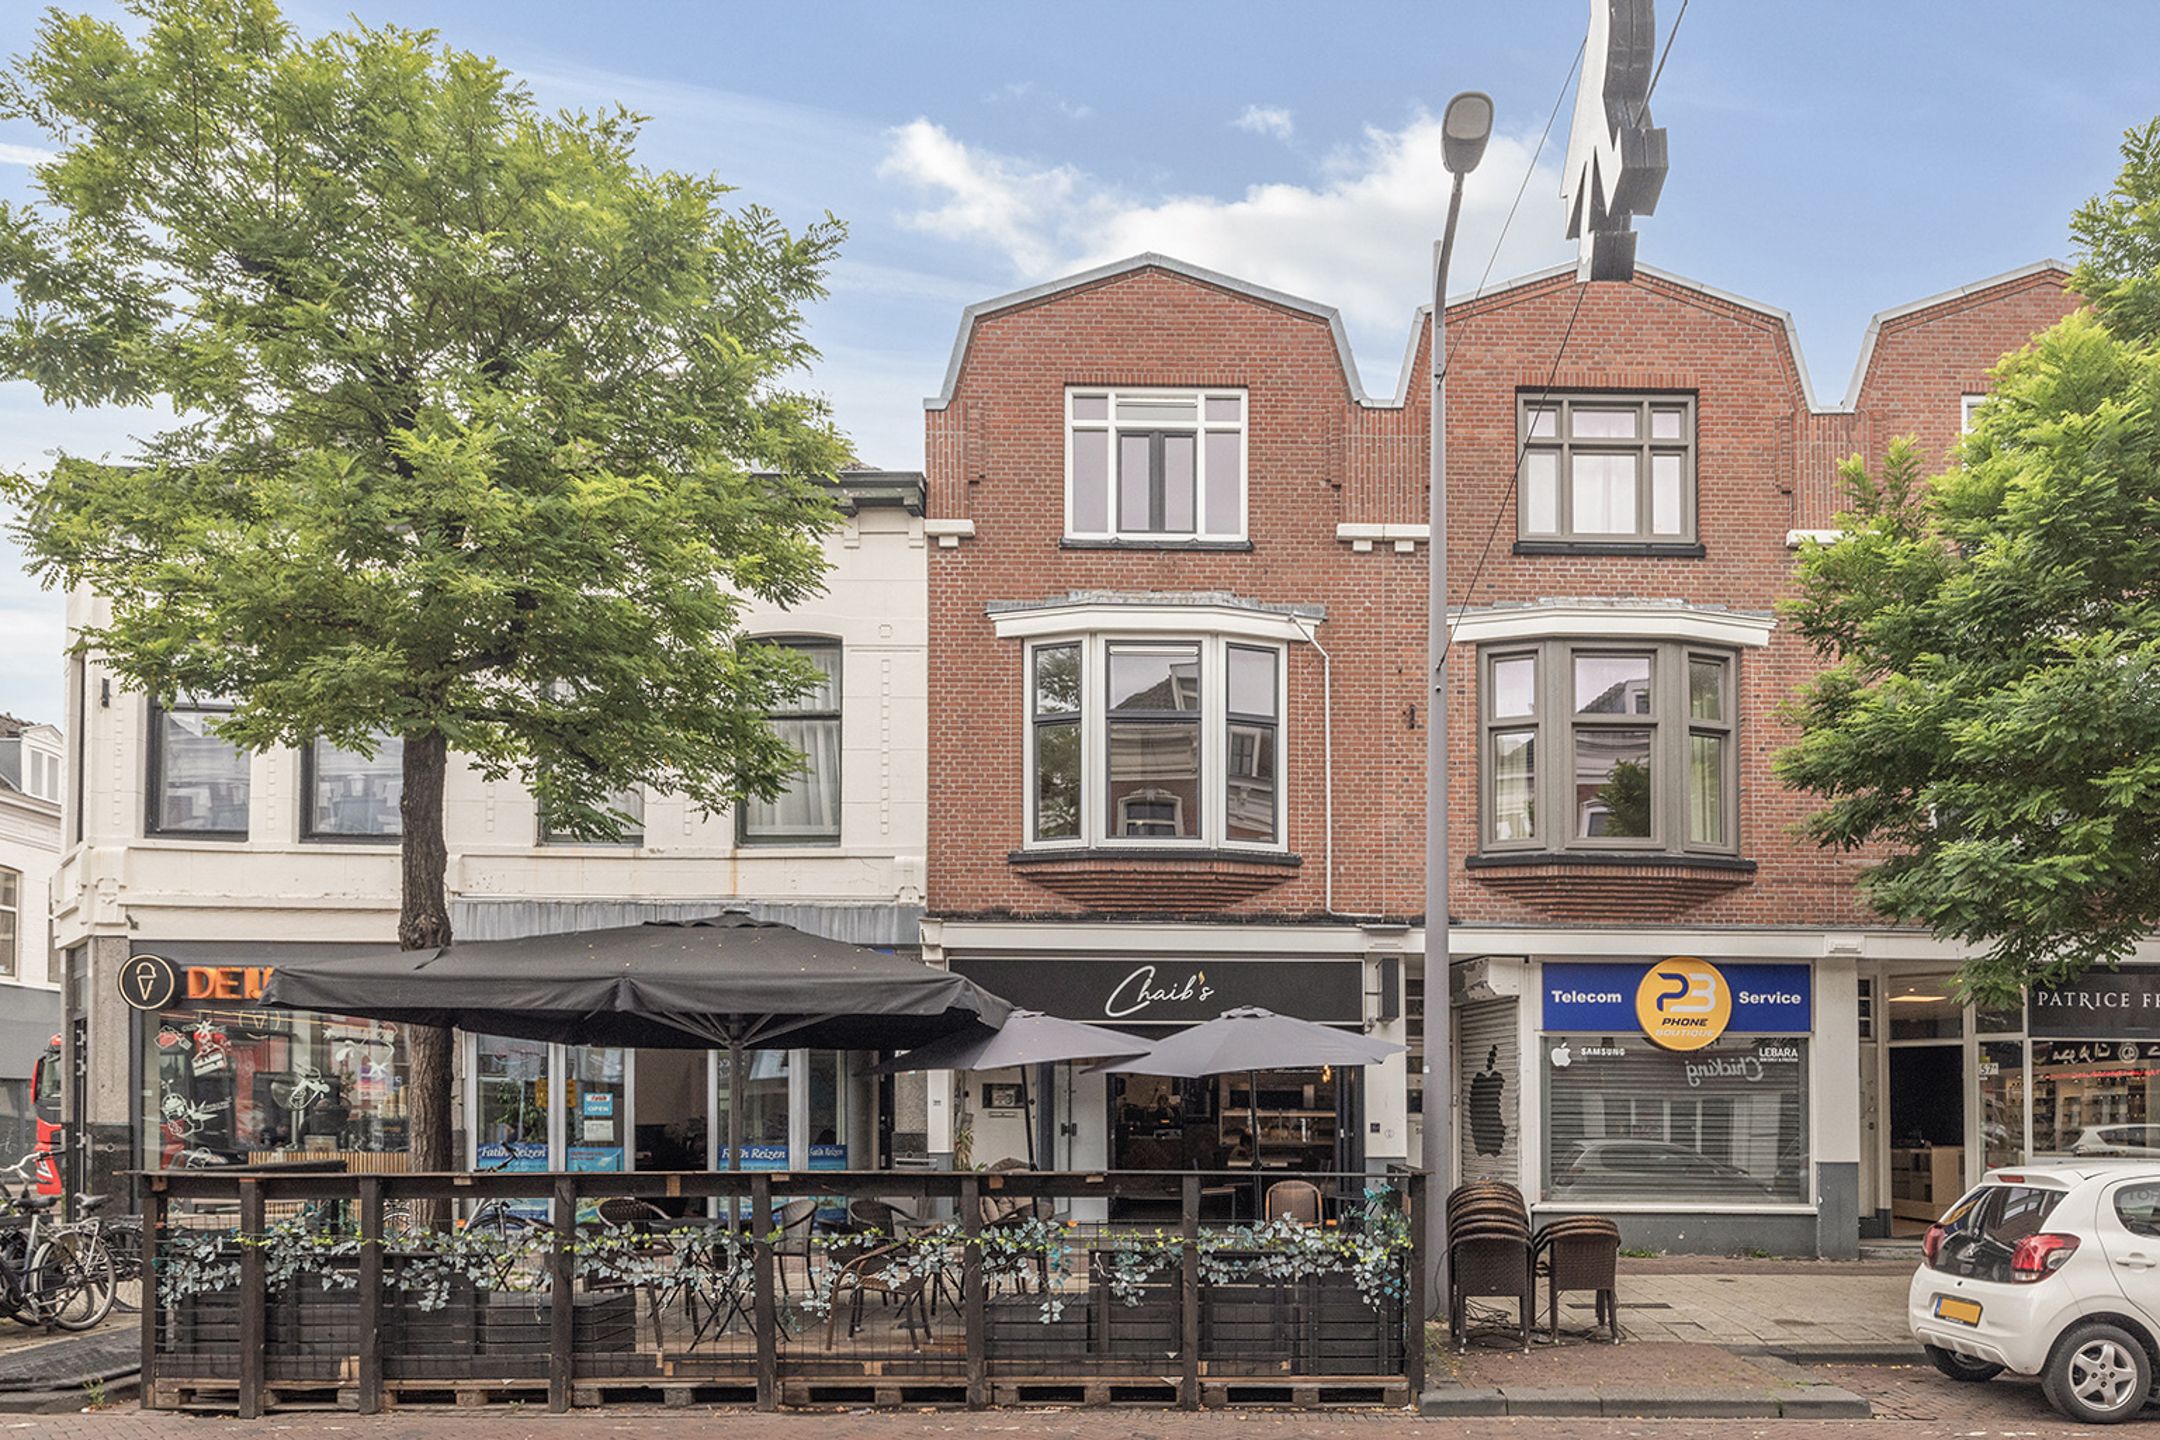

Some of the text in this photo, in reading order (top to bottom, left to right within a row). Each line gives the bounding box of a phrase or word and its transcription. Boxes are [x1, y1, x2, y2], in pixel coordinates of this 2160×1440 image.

[1105, 965, 1214, 1017] Chaib's
[1551, 989, 1622, 1003] Telecom
[1738, 990, 1802, 1005] Service
[2038, 991, 2130, 1011] PATRICE
[1661, 1017, 1709, 1027] PHONE
[1655, 1029, 1715, 1038] BOUTIQUE
[1580, 1047, 1626, 1056] SAMSUNG
[1759, 1047, 1799, 1057] LEBARA
[751, 1148, 786, 1160] Reizen
